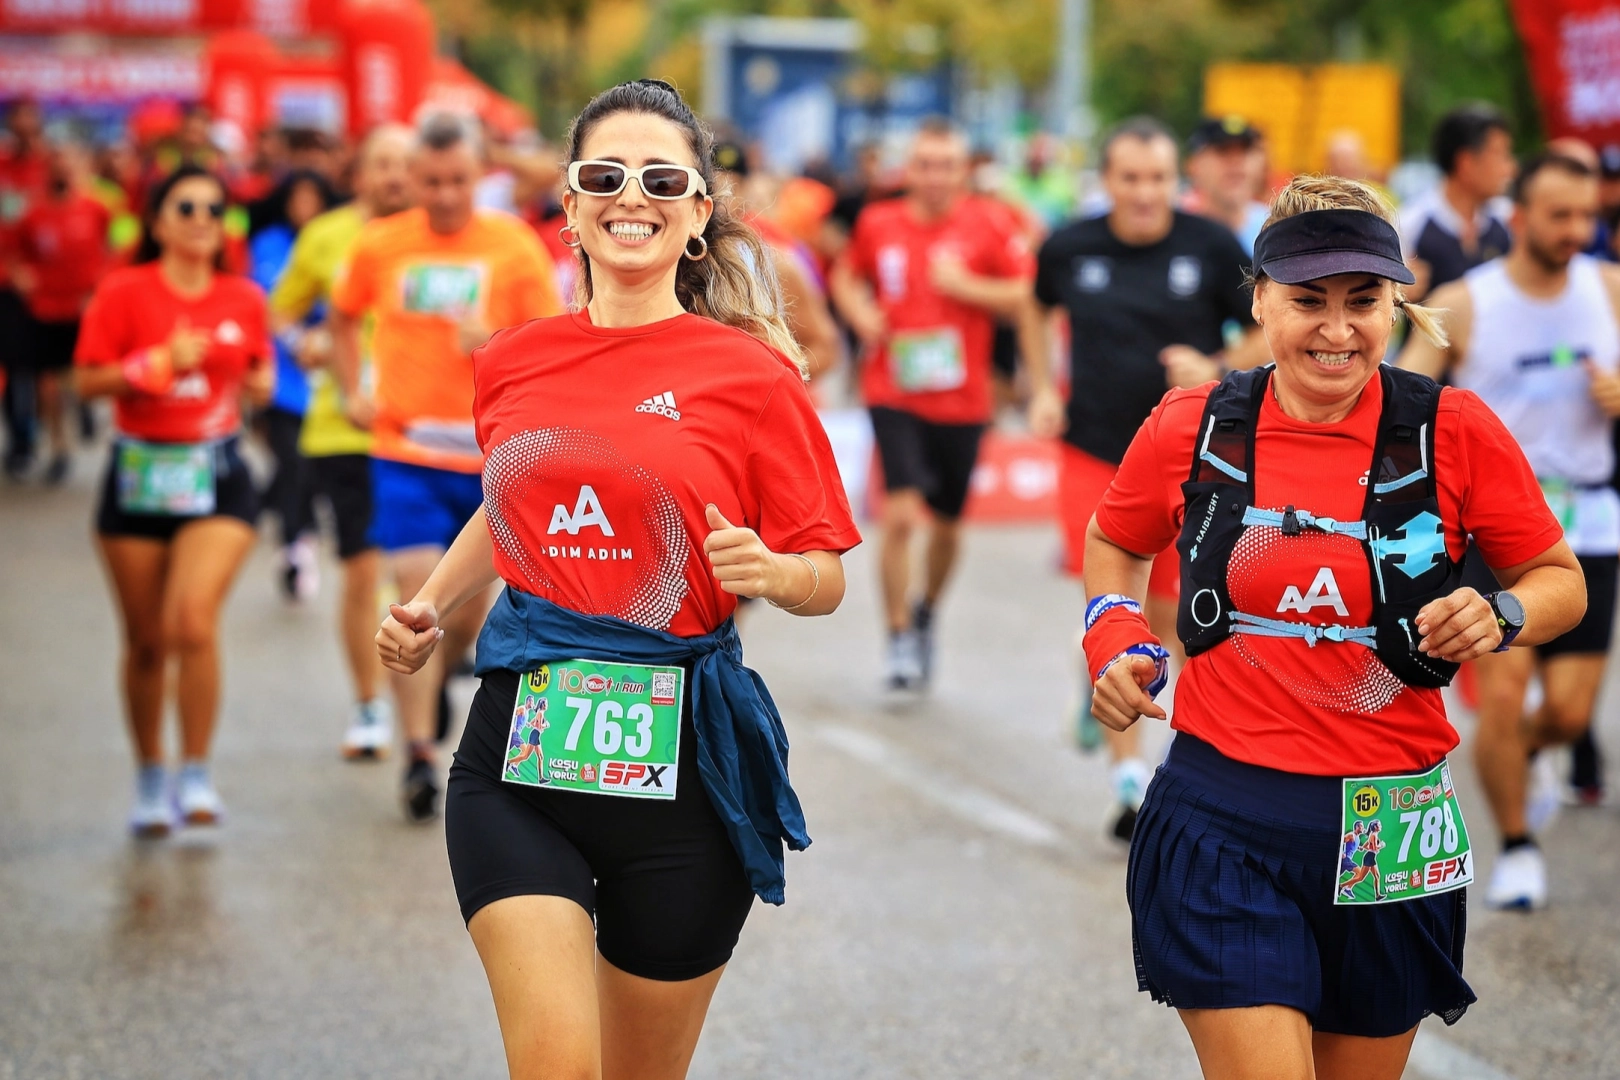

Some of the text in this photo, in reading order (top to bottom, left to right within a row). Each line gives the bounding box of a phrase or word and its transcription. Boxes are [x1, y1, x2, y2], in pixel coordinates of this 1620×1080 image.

[635, 402, 681, 421] adidas
[1195, 492, 1219, 544] RAIDLIGHT
[587, 548, 633, 561] ADIM
[621, 682, 645, 694] RUN
[564, 696, 654, 757] 763
[548, 770, 578, 781] YORUZ
[602, 762, 669, 787] SPX
[1354, 793, 1378, 812] 15K
[1397, 800, 1458, 863] 788
[1427, 853, 1468, 885] SPX
[1384, 882, 1408, 893] YORUZ
